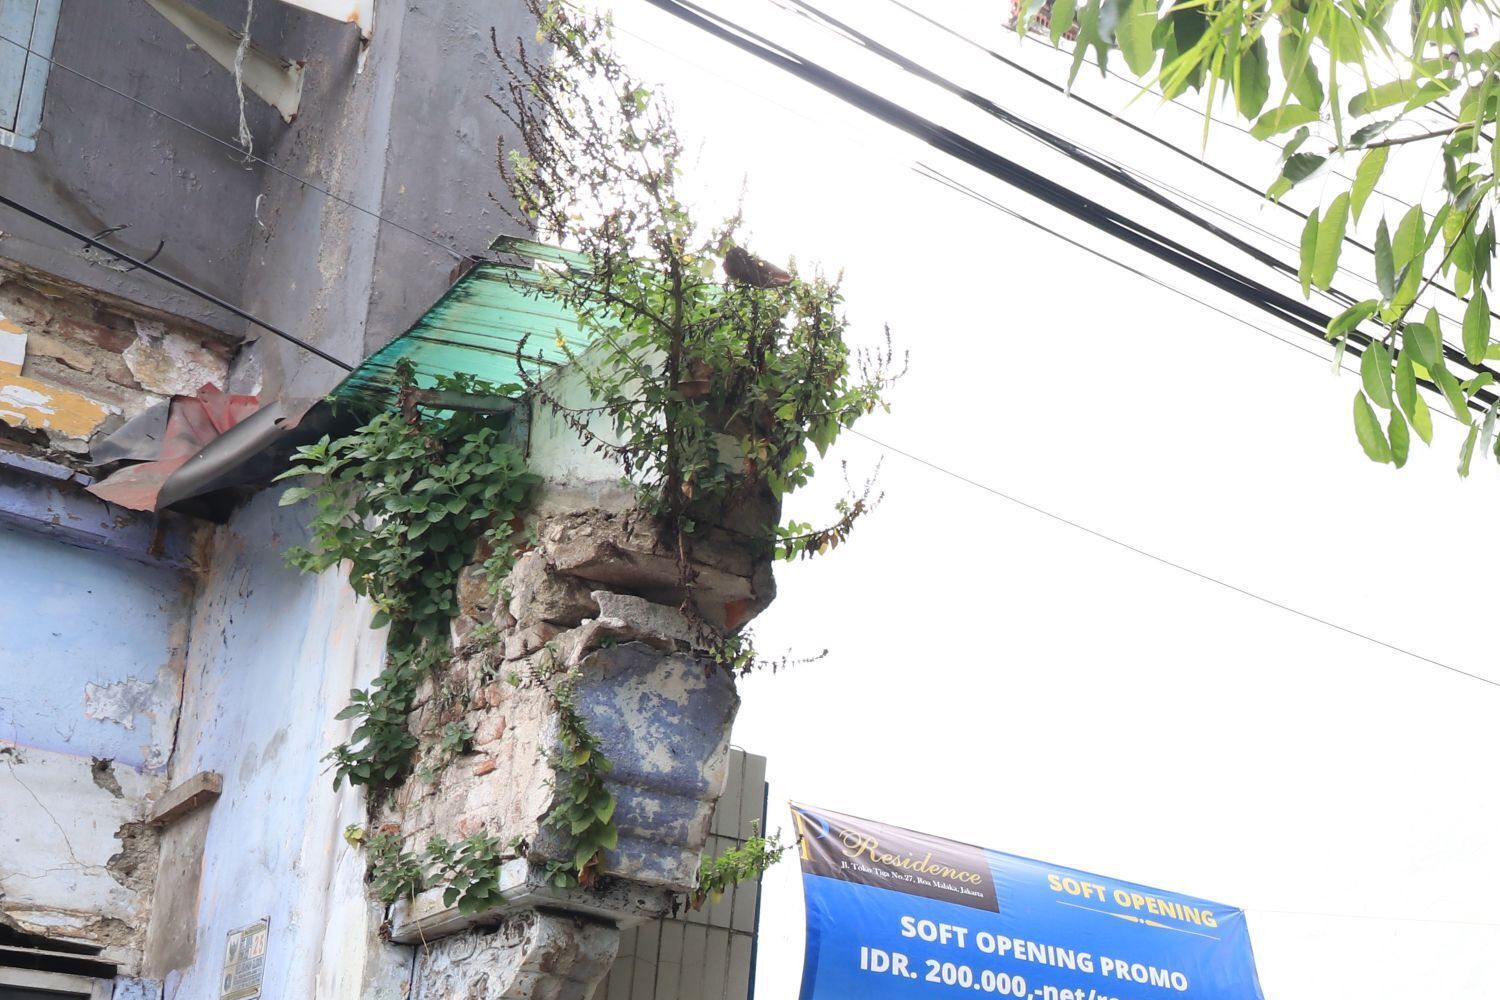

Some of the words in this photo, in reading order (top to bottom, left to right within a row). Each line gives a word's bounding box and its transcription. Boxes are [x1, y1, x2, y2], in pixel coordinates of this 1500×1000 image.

[838, 829, 983, 886] Residence
[873, 867, 890, 880] Tiga
[917, 876, 931, 886] Roa
[932, 879, 960, 893] Malaka,
[960, 884, 984, 898] Jakarta
[1047, 873, 1106, 904] SOFT
[1113, 889, 1218, 928] OPENING
[860, 946, 918, 979] IDR.
[900, 915, 968, 949] SOFT
[975, 931, 1094, 975] OPENING
[1100, 956, 1188, 992] PROMO
